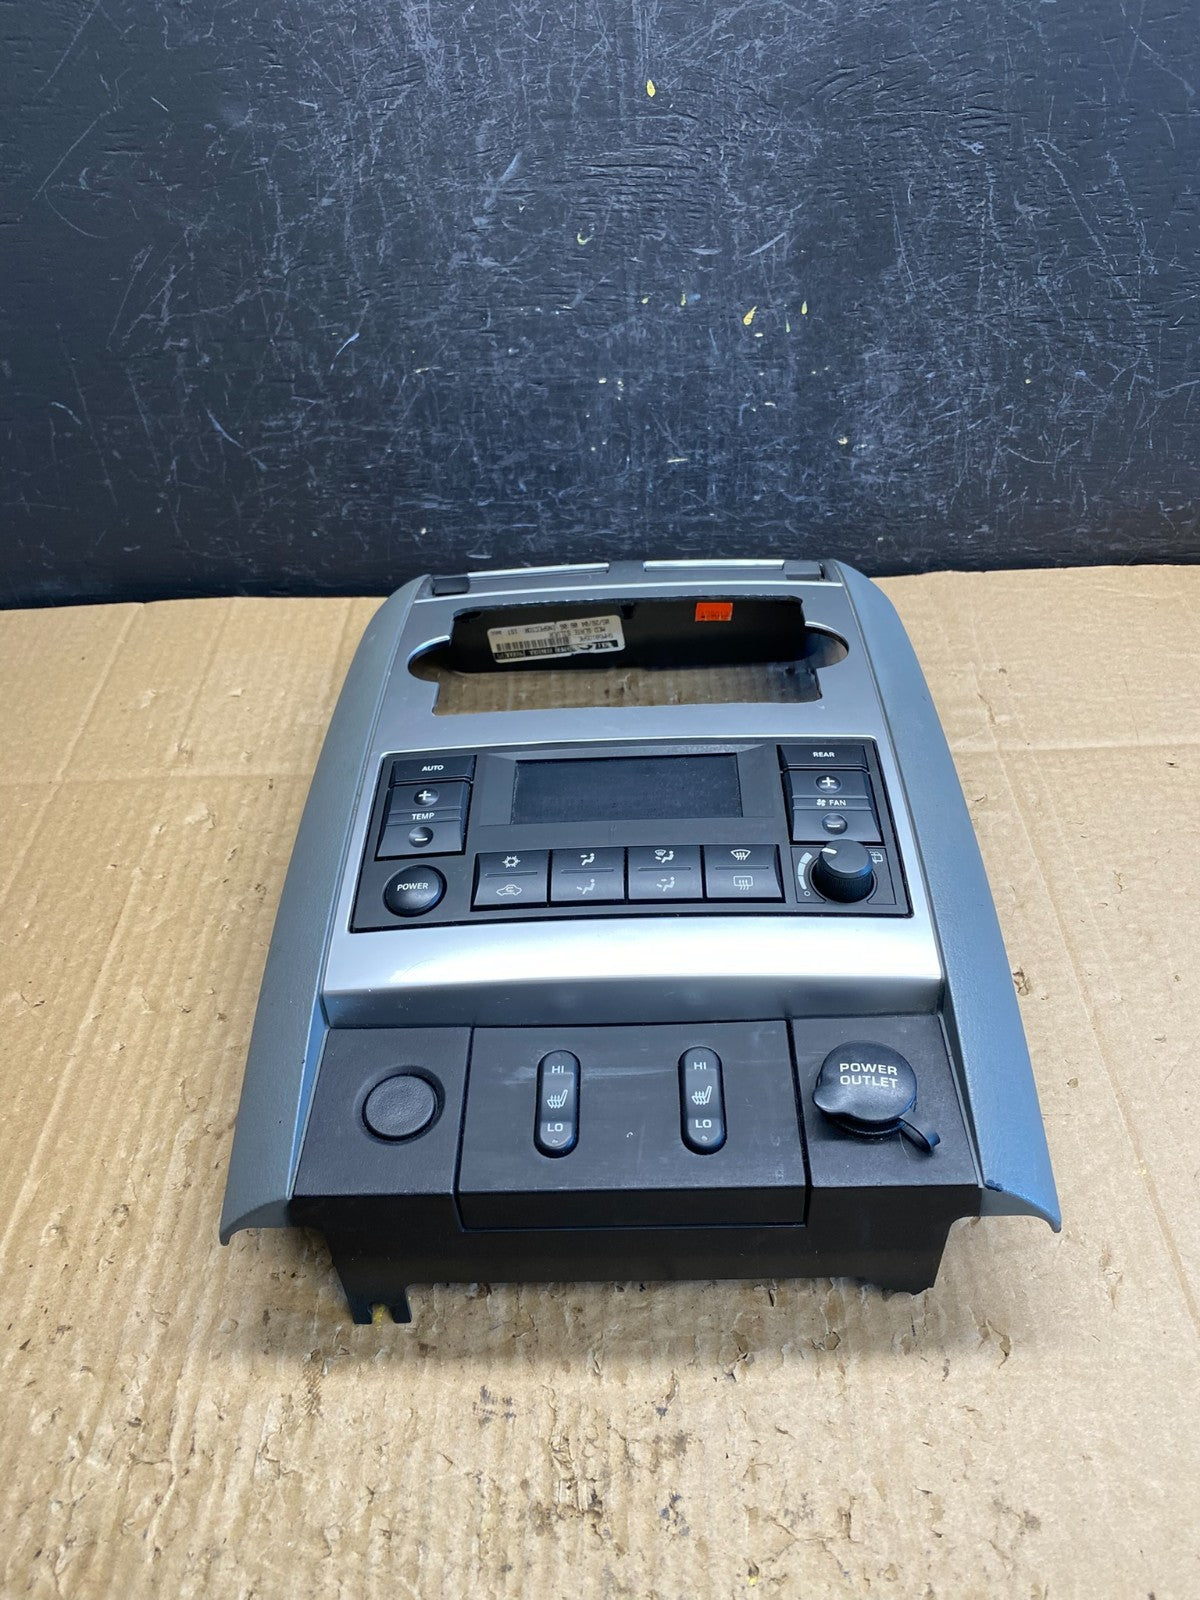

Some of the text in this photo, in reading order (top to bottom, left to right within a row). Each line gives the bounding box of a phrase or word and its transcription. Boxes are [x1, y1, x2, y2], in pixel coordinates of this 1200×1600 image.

[421, 764, 444, 772] AUTO
[829, 799, 846, 807] FAN
[411, 812, 435, 821] TEMP
[396, 882, 429, 892] POWER
[551, 1065, 565, 1074] HI
[693, 1061, 707, 1070] HI
[839, 1062, 898, 1076] POWER
[839, 1075, 898, 1089] OUTLET
[547, 1122, 564, 1132] LO
[695, 1119, 712, 1129] LO
